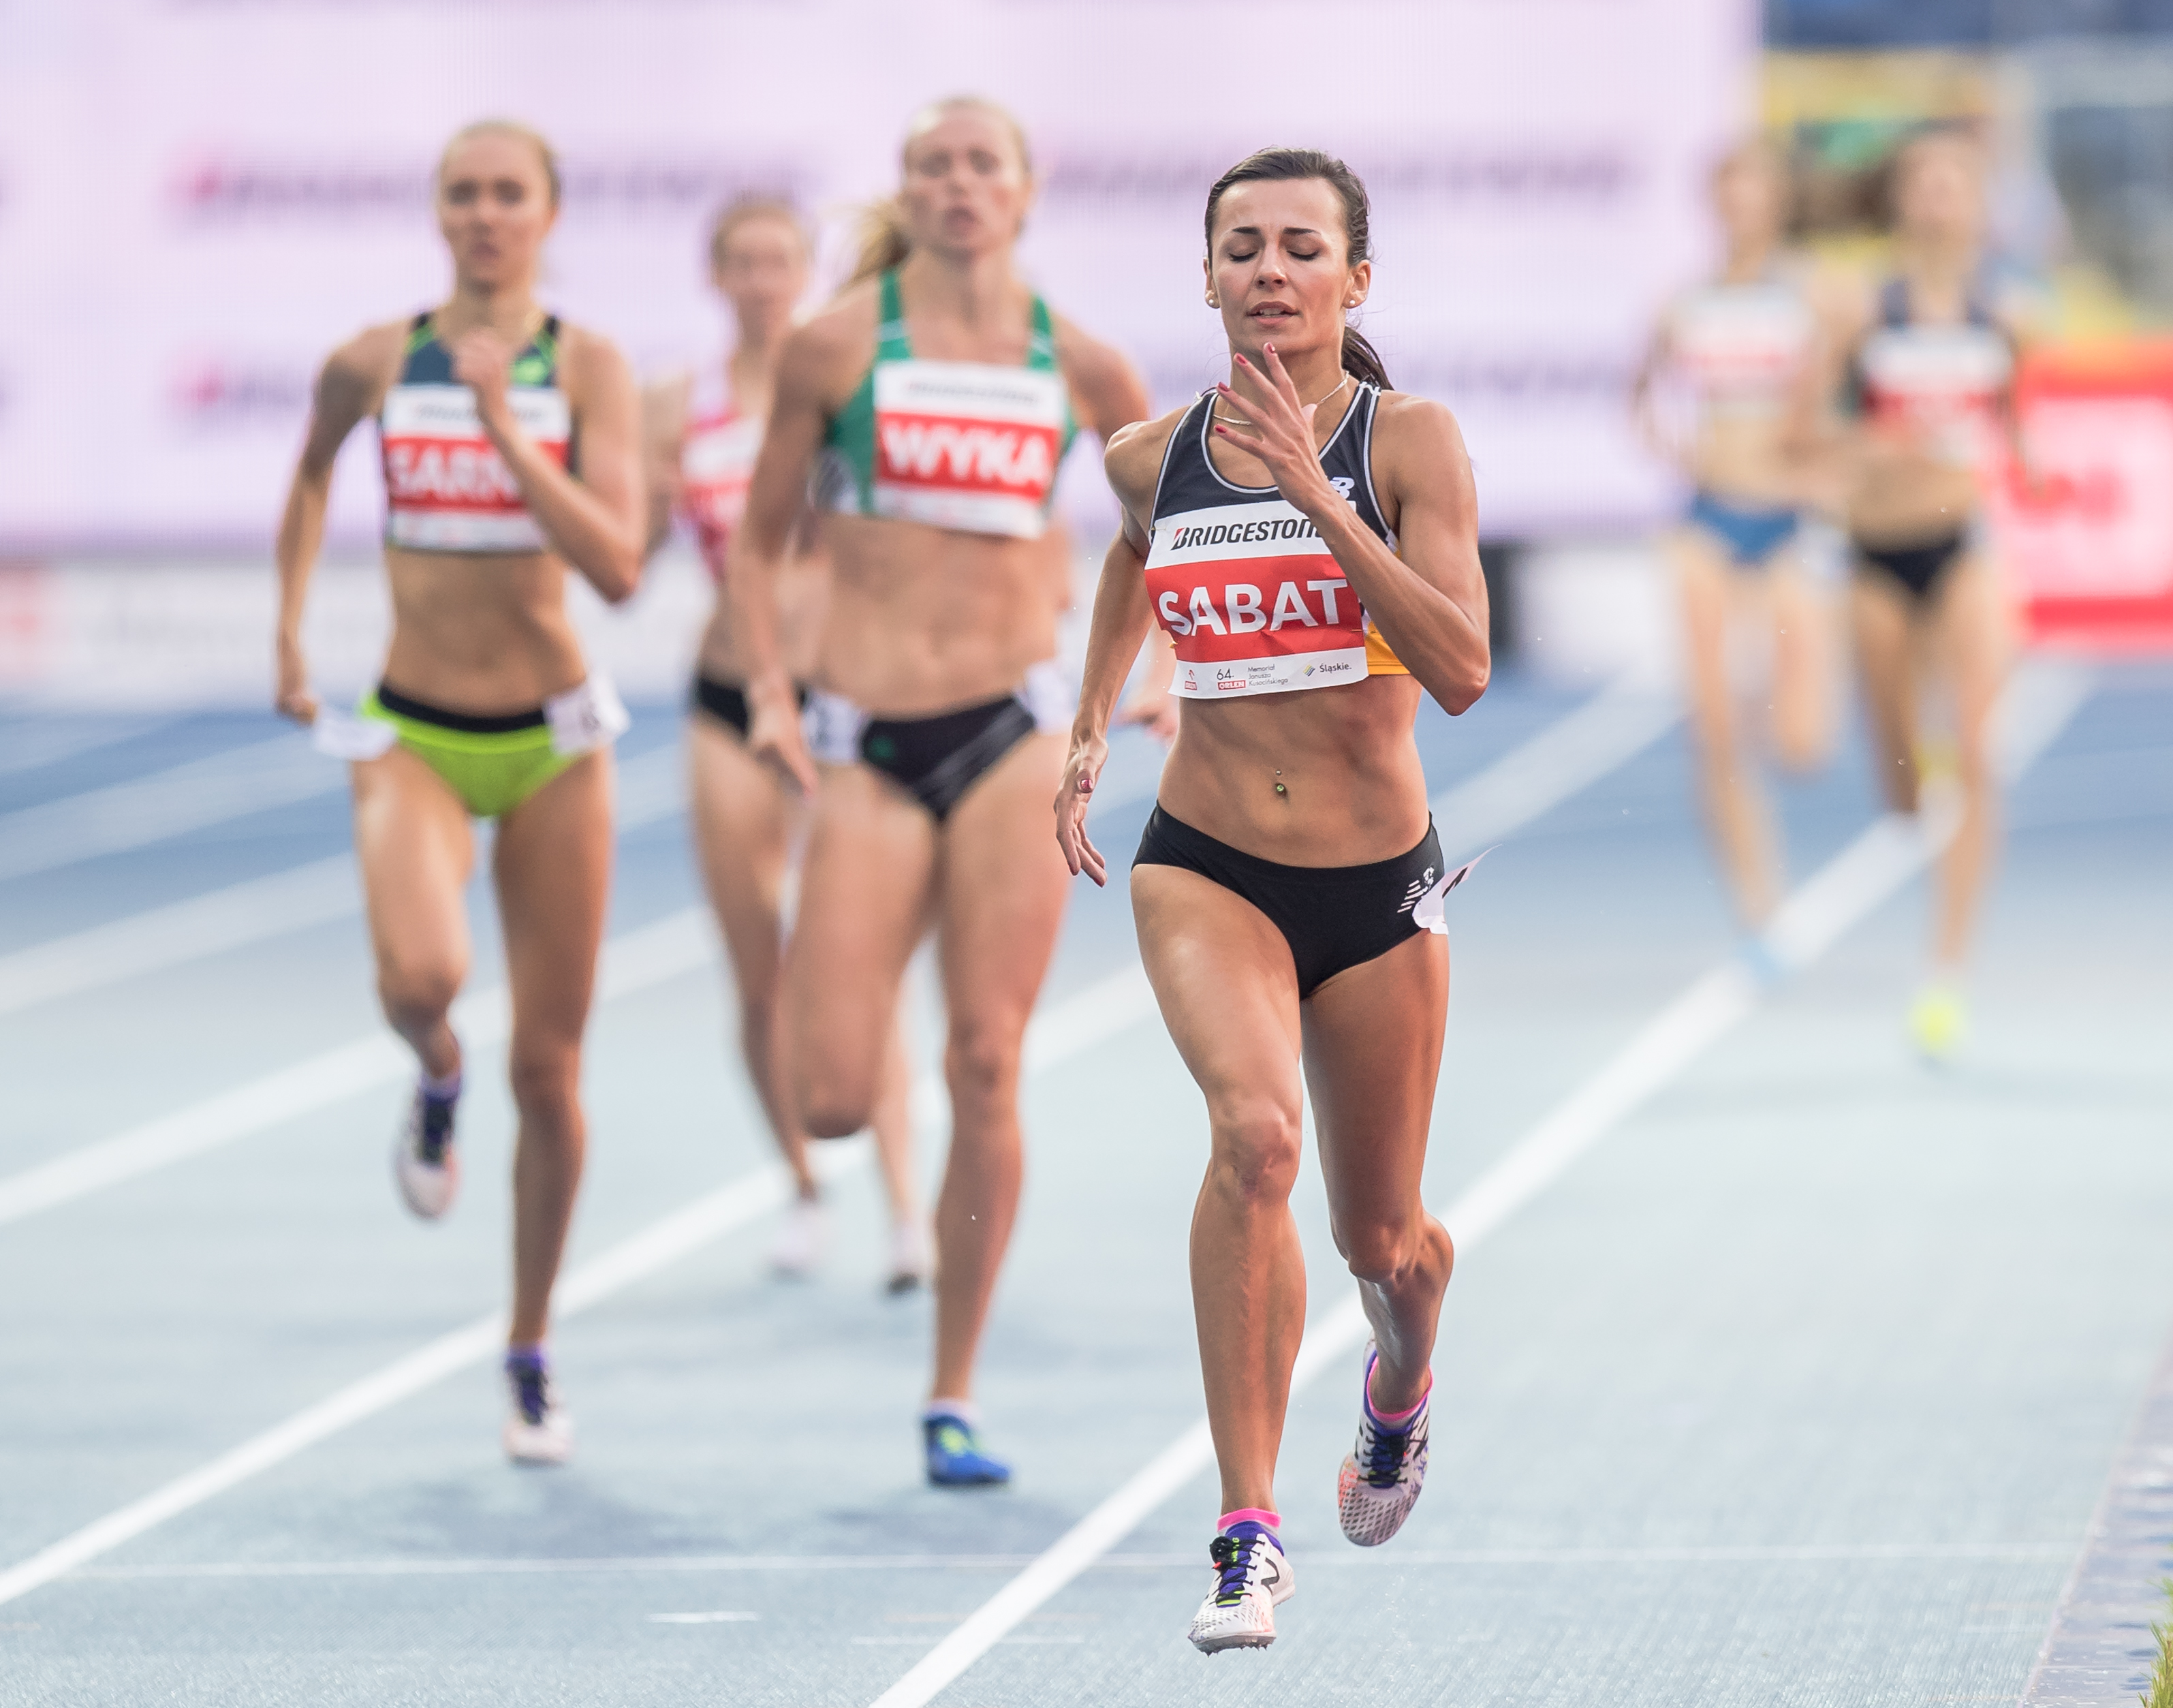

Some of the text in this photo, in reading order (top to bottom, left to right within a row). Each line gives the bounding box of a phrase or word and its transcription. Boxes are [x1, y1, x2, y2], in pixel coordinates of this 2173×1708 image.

[884, 420, 1050, 485] WYKA
[1159, 578, 1347, 636] SABAT
[1219, 681, 1245, 689] ORLEN
